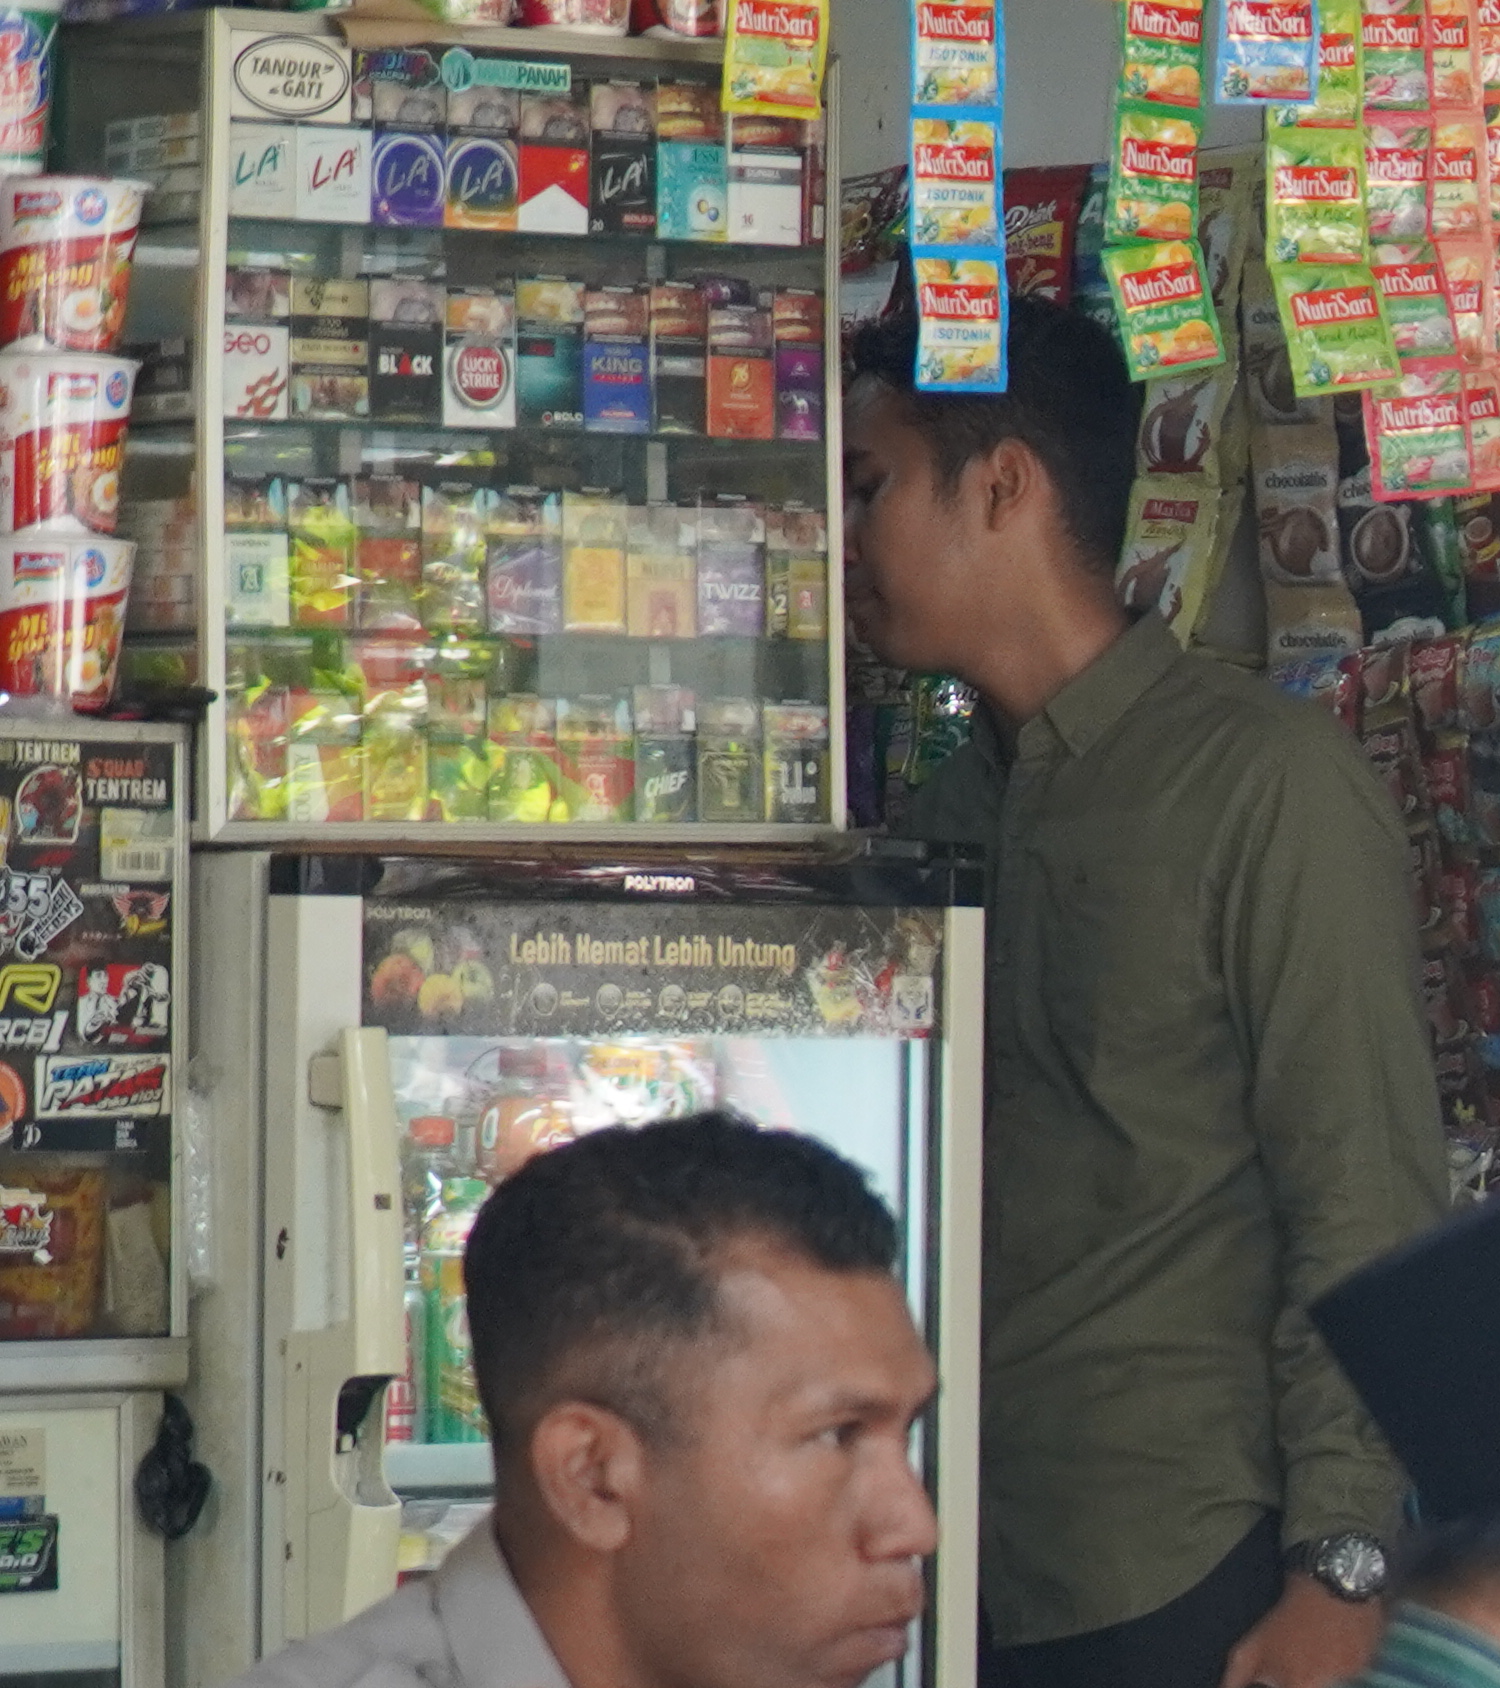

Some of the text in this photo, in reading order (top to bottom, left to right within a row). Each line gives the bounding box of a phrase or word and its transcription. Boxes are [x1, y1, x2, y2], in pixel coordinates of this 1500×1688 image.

[738, 2, 814, 36] NutriSari
[922, 5, 990, 37] NutriSari
[1131, 3, 1200, 38] NutriSari
[252, 57, 321, 76] TANDUR
[282, 80, 325, 99] GATI
[918, 148, 990, 178] NutriSari
[1125, 143, 1193, 175] NutriSari
[1278, 169, 1354, 197] NutriSari
[923, 285, 995, 317] NutriSari
[1123, 271, 1196, 305] NutriSari
[1295, 291, 1375, 322] NutriSari
[463, 357, 499, 374] LUCKY
[591, 356, 644, 374] KING
[461, 371, 500, 389] STRIKE
[1381, 398, 1459, 428] NutriSari
[703, 583, 762, 601] TWIZZ
[86, 777, 168, 801] TENTREM
[643, 771, 690, 800] CHIEF
[625, 875, 696, 893] POLYTRON
[510, 933, 797, 974] Lebih Hemat Lebih Untung
